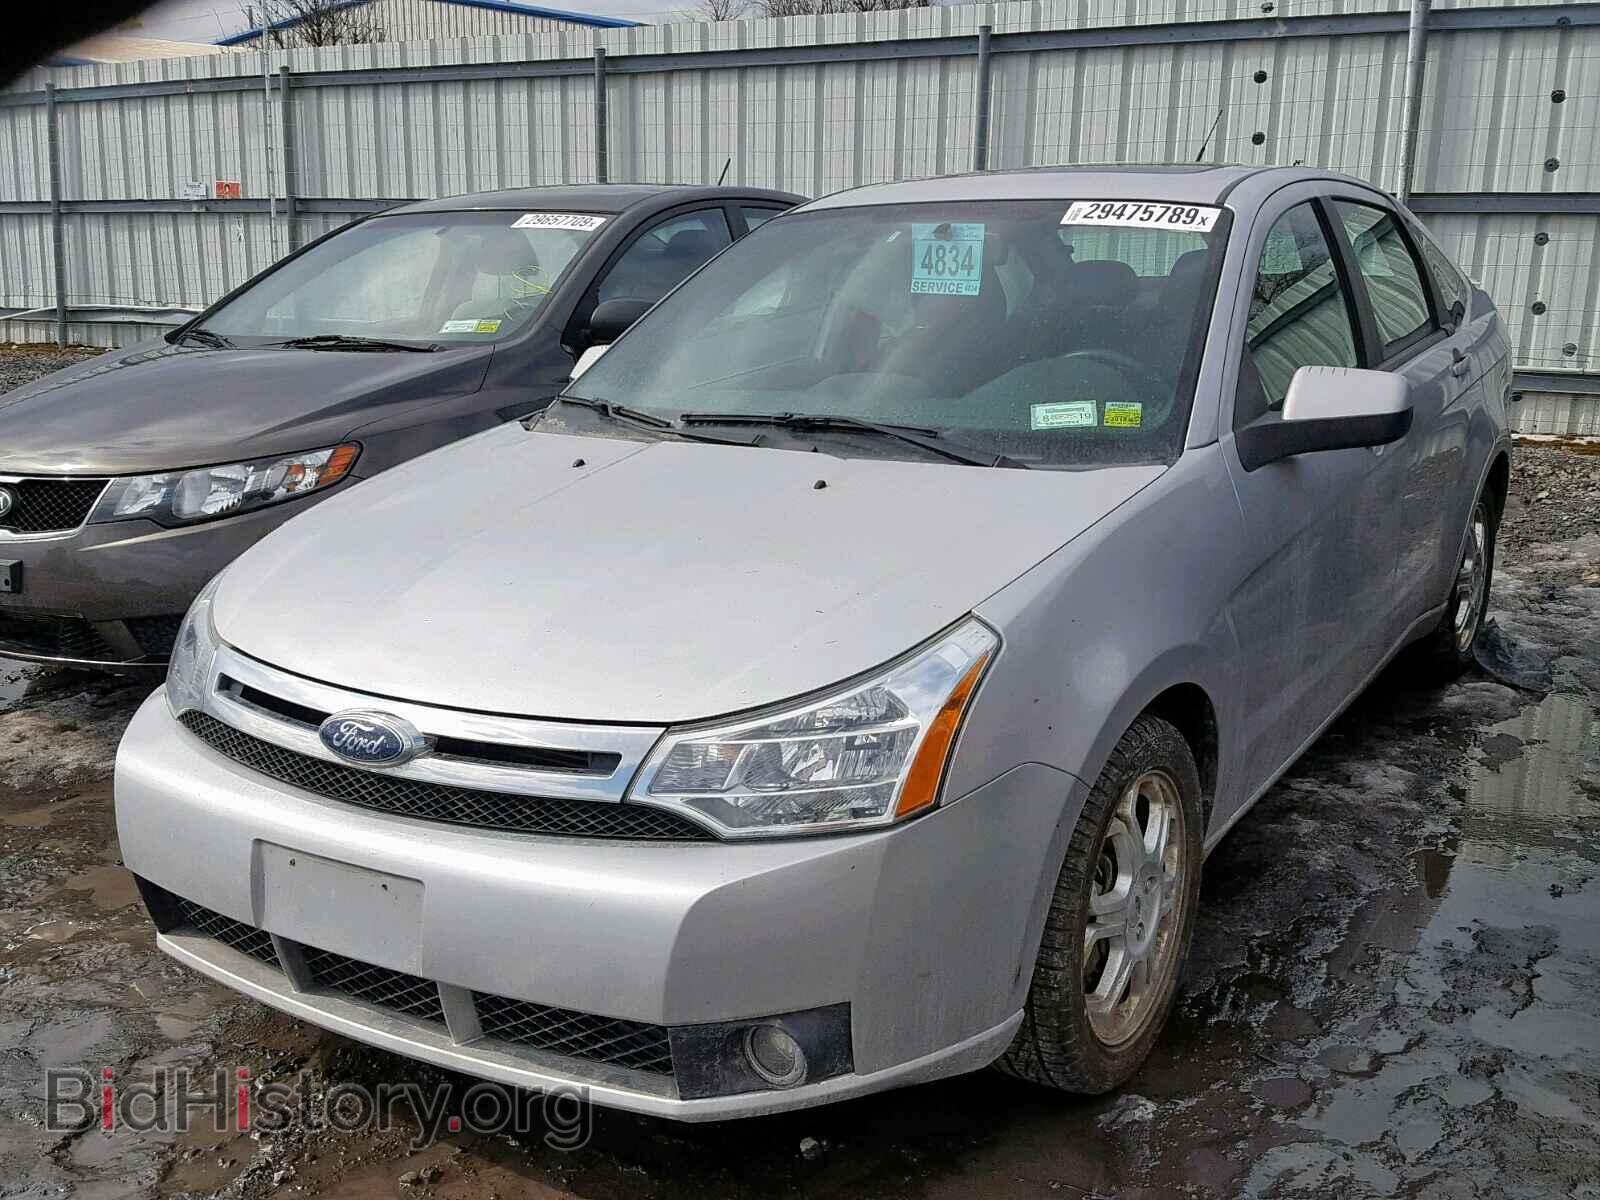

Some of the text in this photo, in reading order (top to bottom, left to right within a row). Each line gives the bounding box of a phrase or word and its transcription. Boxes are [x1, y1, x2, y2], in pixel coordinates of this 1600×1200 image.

[920, 245, 975, 276] 4834
[912, 281, 964, 293] SERVICE
[333, 721, 384, 755] Ford
